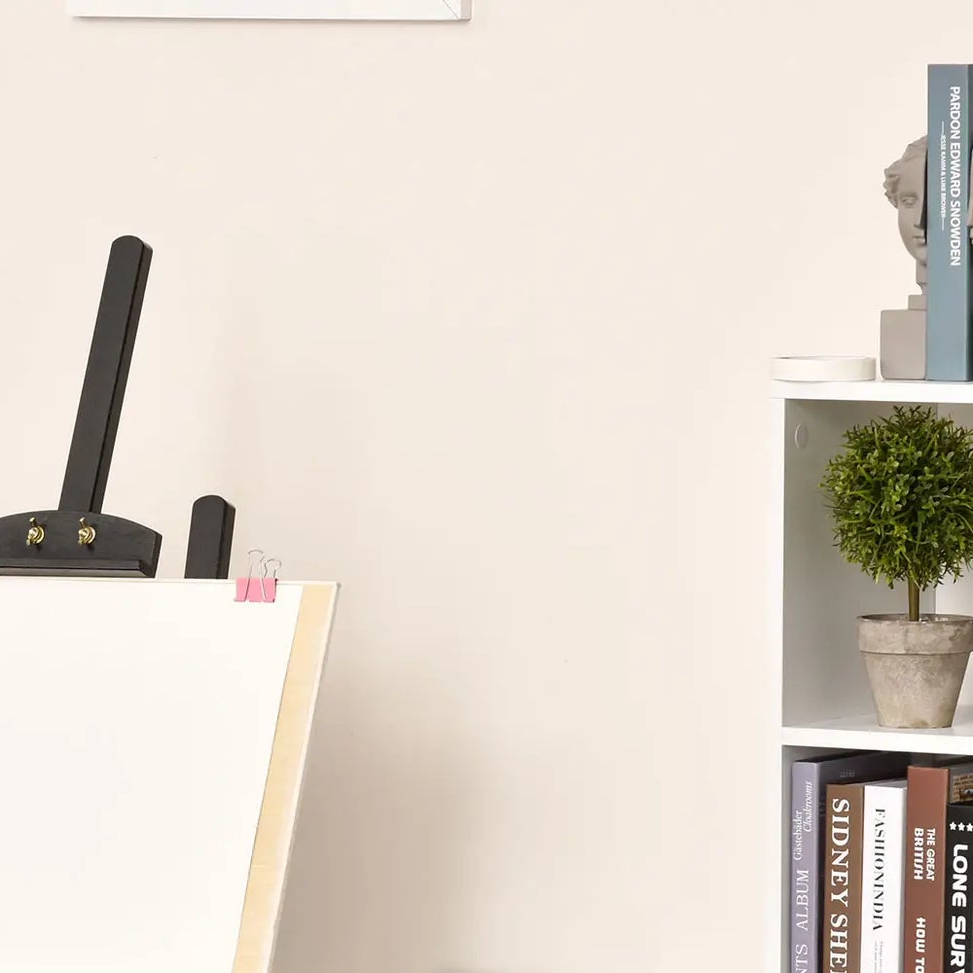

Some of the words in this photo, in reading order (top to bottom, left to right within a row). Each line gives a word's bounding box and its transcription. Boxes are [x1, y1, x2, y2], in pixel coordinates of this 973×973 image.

[949, 86, 961, 140] PARDON
[949, 143, 961, 198] EDWARD
[949, 200, 961, 266] SNOWDEN
[802, 780, 814, 833] Cloakrooms
[830, 797, 851, 908] SIDNEY
[913, 827, 924, 880] BRITISH
[926, 828, 936, 846] THE
[926, 848, 936, 881] GREAT
[951, 843, 969, 908] LONE
[795, 869, 810, 932] ALBUM
[915, 917, 926, 953] HOW
